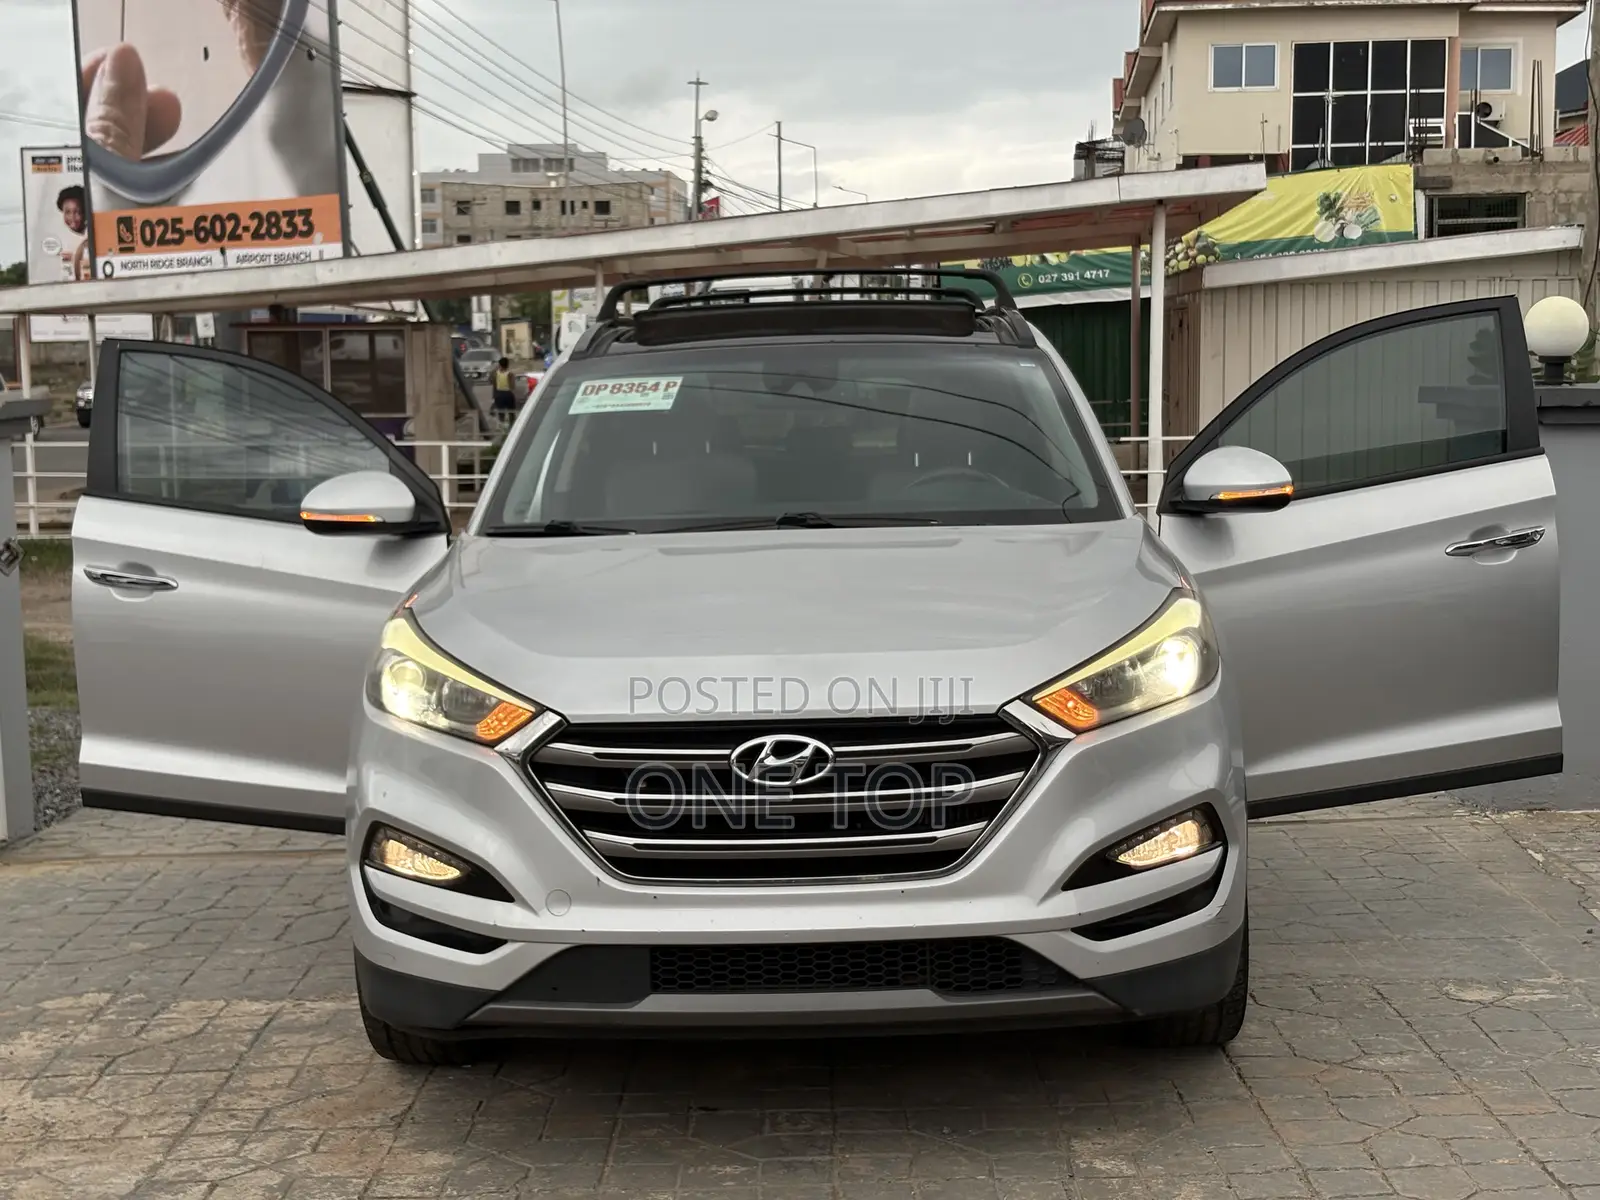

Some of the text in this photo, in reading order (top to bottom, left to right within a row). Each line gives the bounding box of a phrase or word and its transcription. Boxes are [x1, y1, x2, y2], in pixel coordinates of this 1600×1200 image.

[140, 208, 315, 247] 025-602-2833
[120, 256, 213, 270] NORTH RIDGE BRANCH
[235, 250, 312, 265] AIRPORT BRANCH
[1038, 269, 1110, 284] 027 391 4717
[581, 381, 679, 397] DP 8354 P
